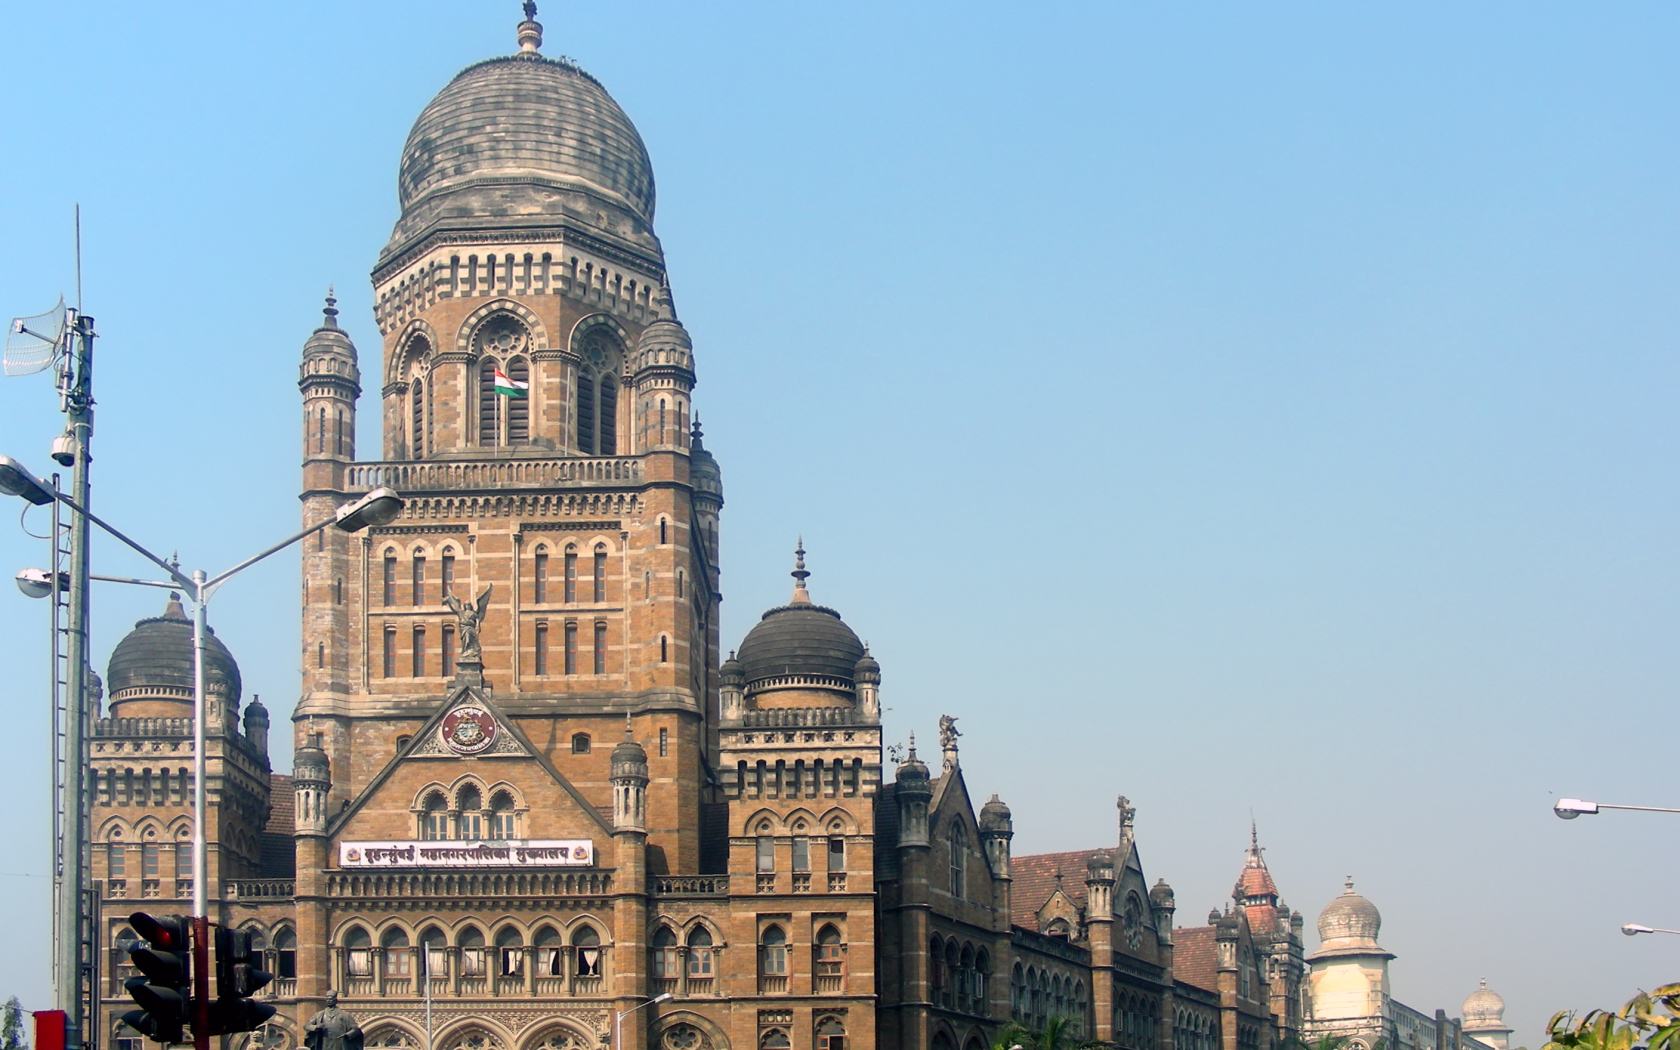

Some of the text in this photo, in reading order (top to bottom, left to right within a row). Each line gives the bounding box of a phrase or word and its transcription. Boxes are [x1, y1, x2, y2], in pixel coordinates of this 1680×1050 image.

[365, 844, 569, 864] बृहन्मुंबई महानगरपालिका मुख्यालय
